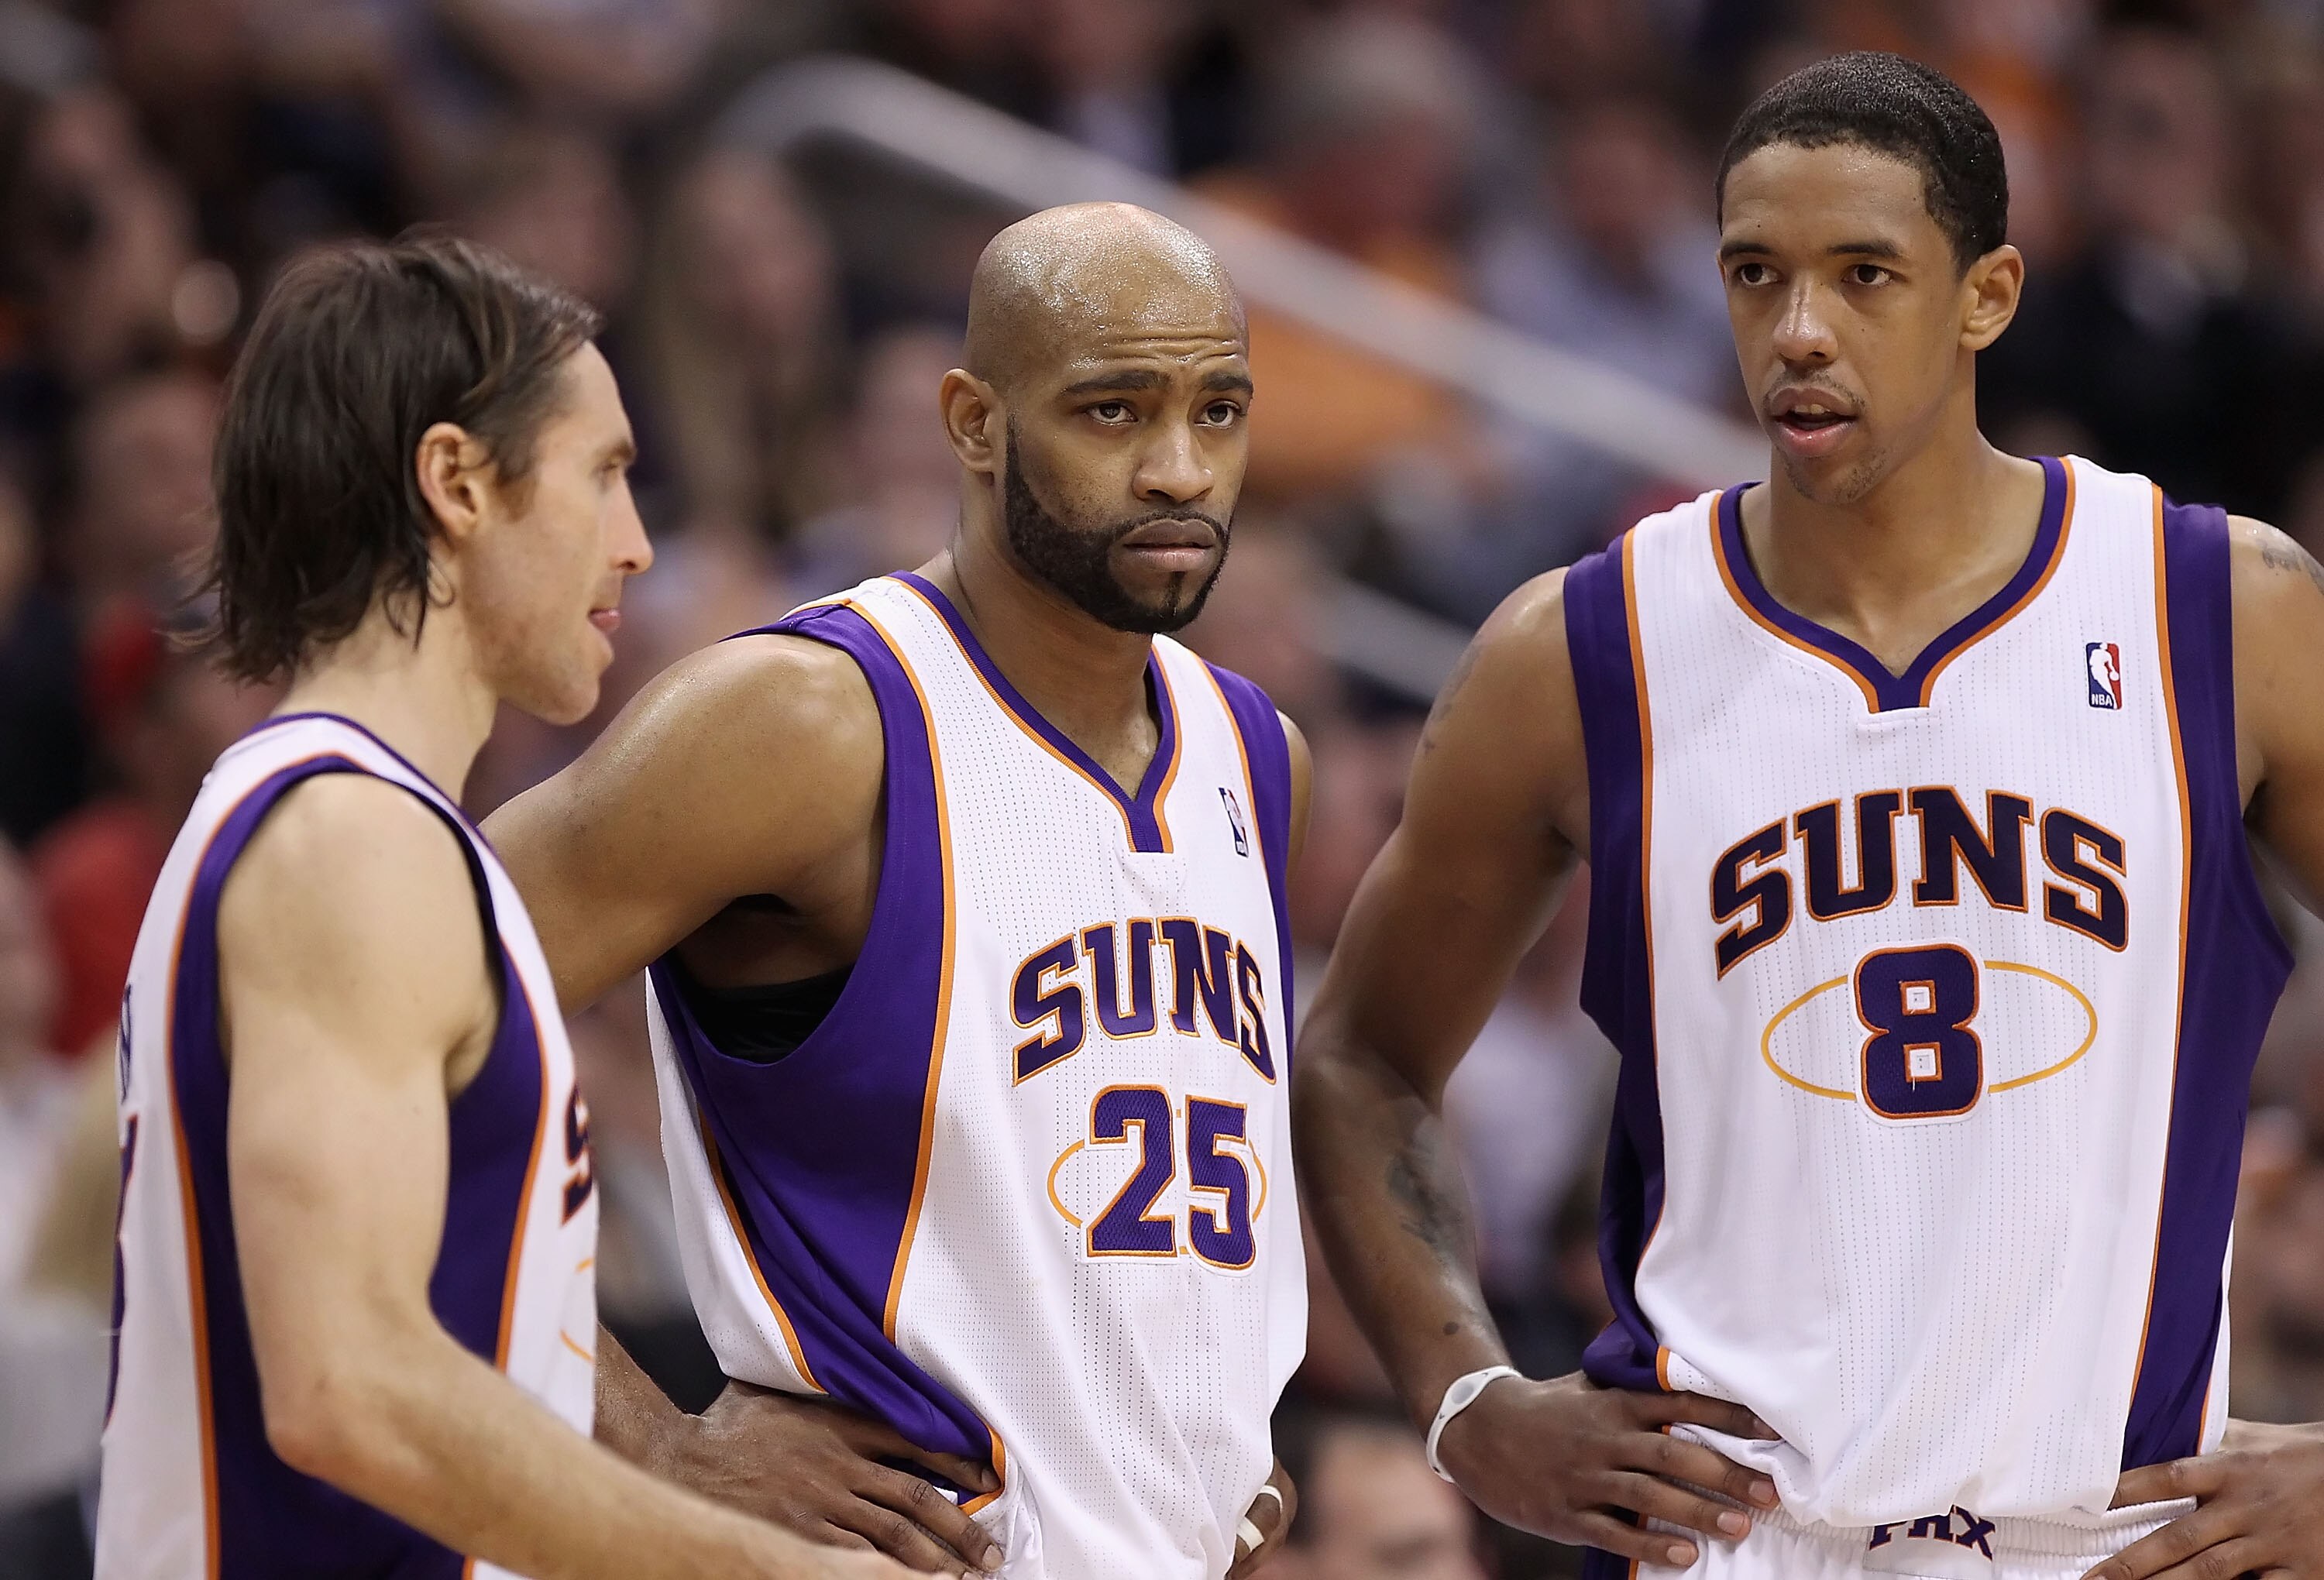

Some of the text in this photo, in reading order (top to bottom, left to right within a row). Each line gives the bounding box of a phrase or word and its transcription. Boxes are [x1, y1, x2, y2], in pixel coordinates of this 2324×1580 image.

[2092, 693, 2113, 706] NBA
[1710, 785, 2128, 981] SUNS
[1009, 916, 1277, 1087] SUNS
[1853, 942, 1983, 1120] 8
[1086, 1083, 1257, 1271] 25
